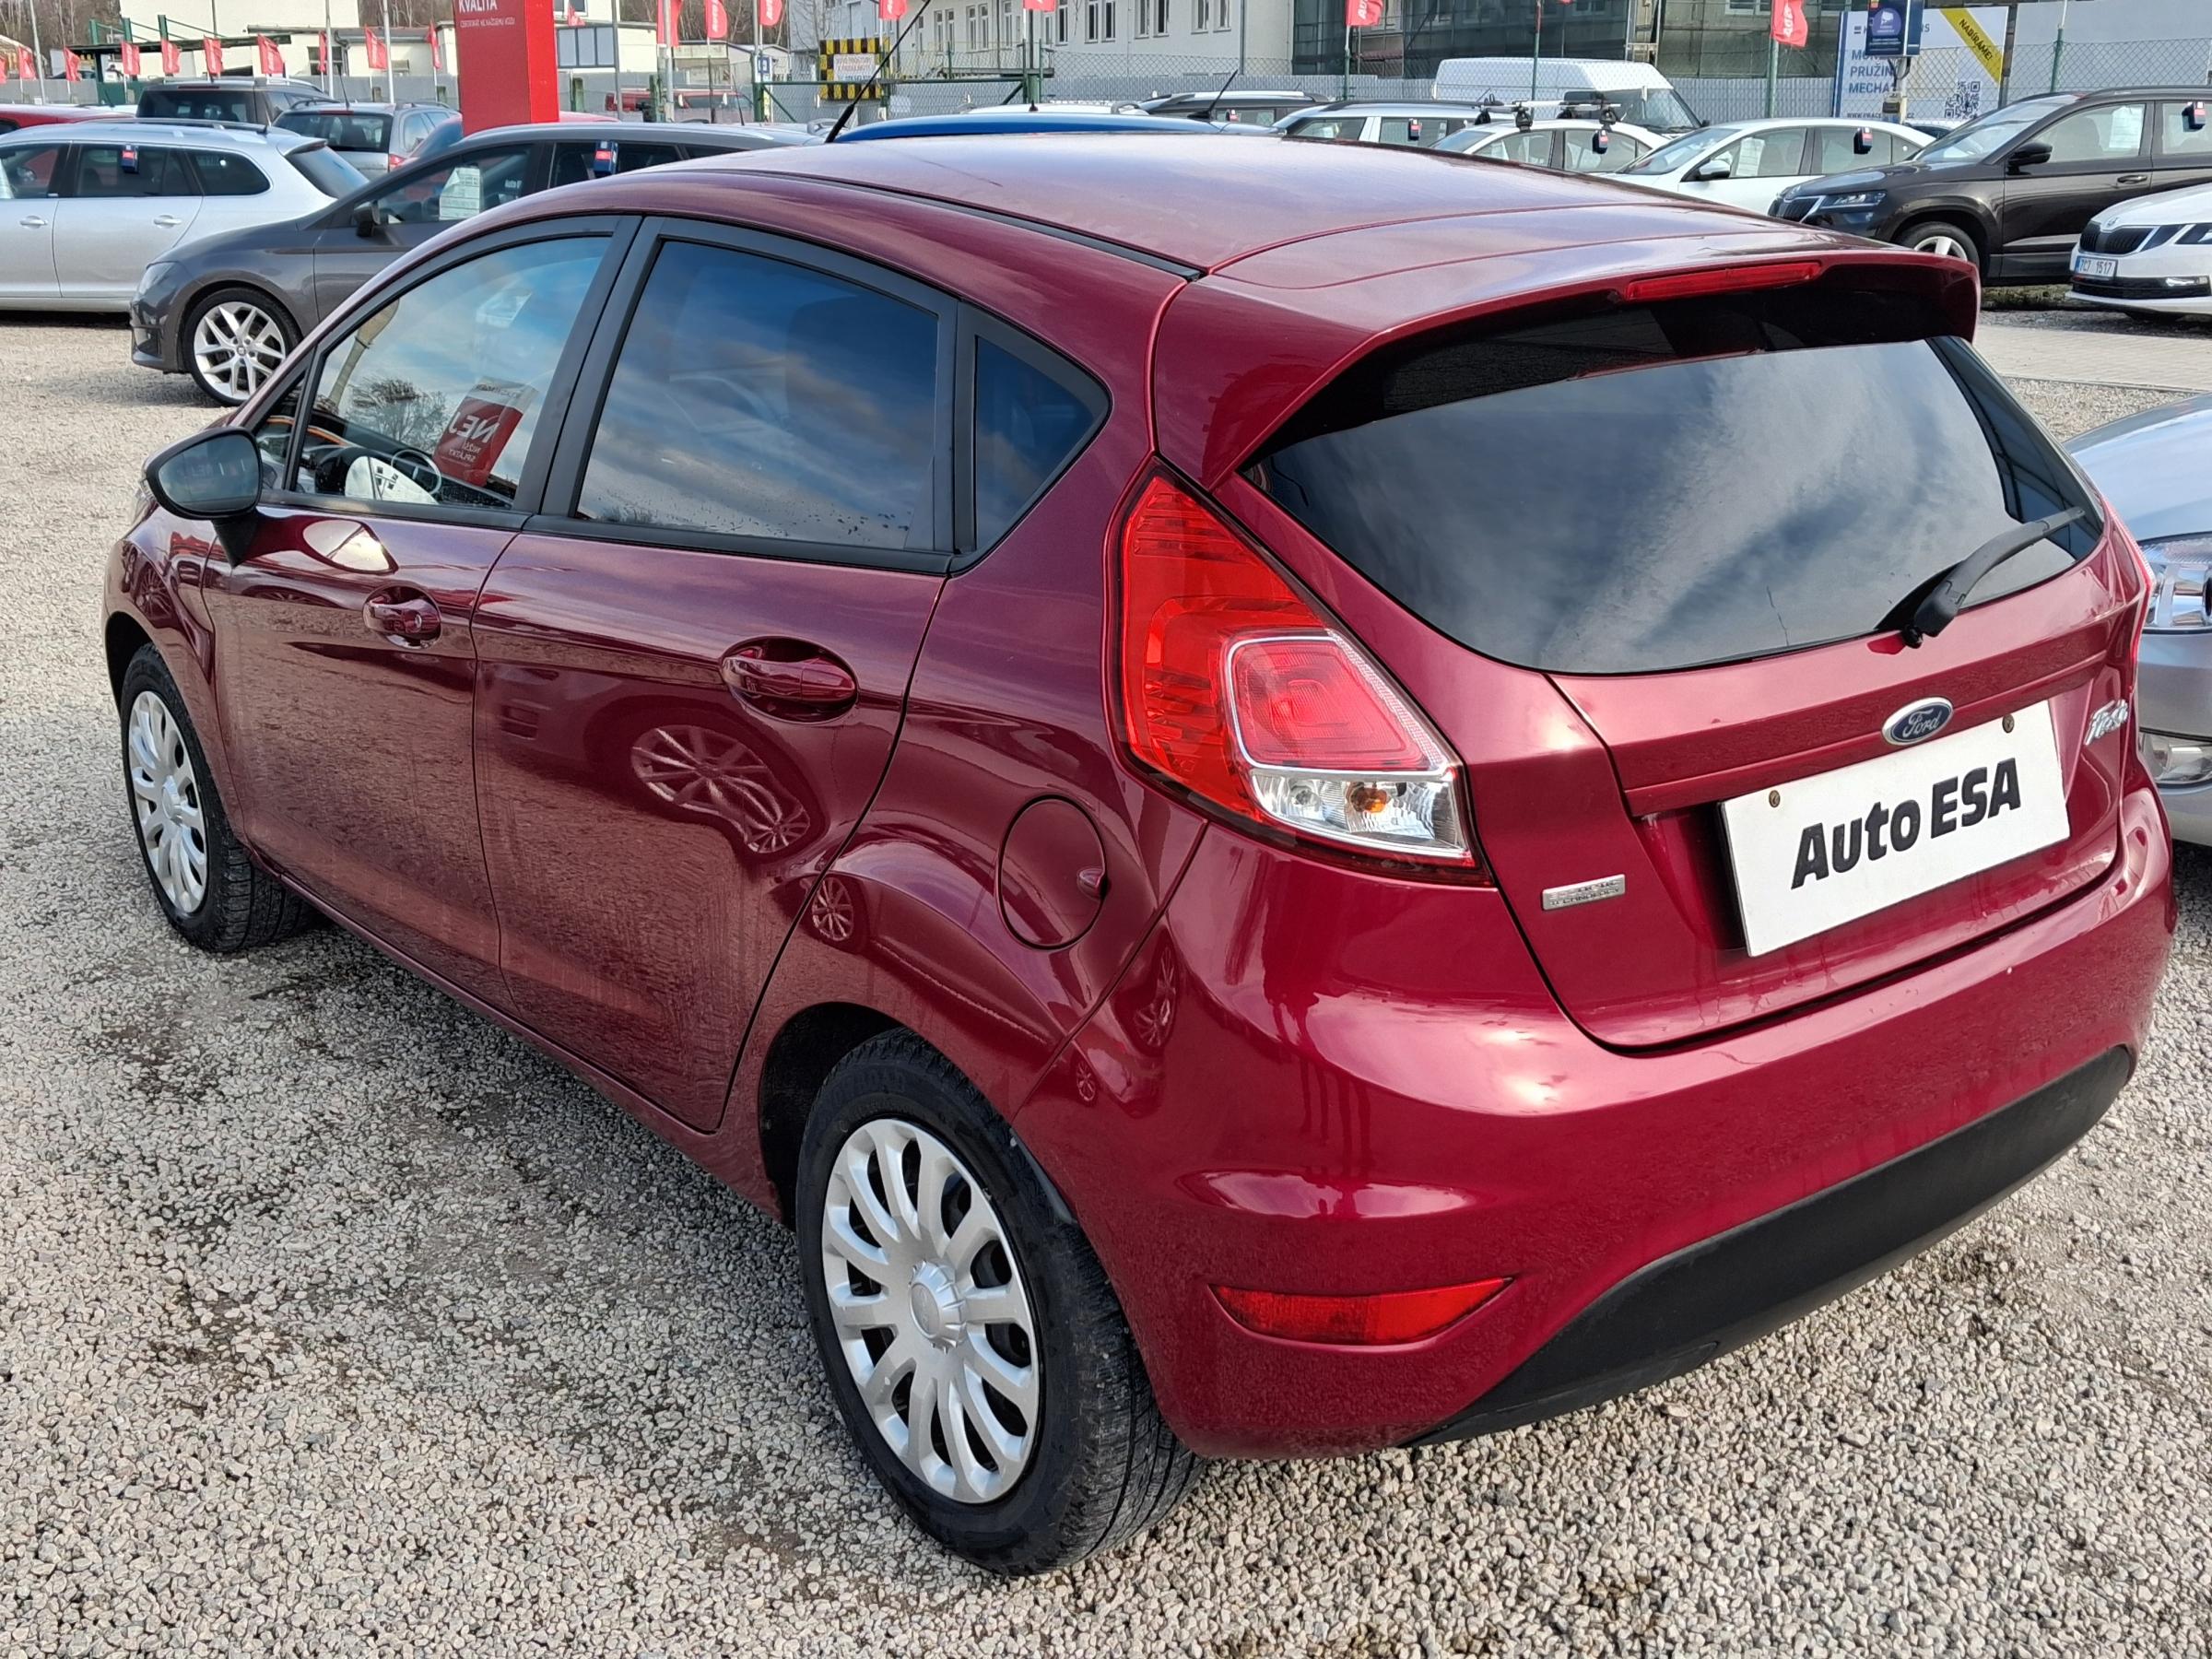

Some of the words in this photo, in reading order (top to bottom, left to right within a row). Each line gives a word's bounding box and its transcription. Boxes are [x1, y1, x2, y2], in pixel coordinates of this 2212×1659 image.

[1959, 18, 1993, 62] NABÍRÁME!
[1851, 63, 1894, 76] PRUŽIN
[1849, 82, 1891, 94] MECHA
[1902, 708, 1943, 738] Ford
[1791, 801, 1921, 890] Auto
[1930, 757, 2021, 840] ESA
